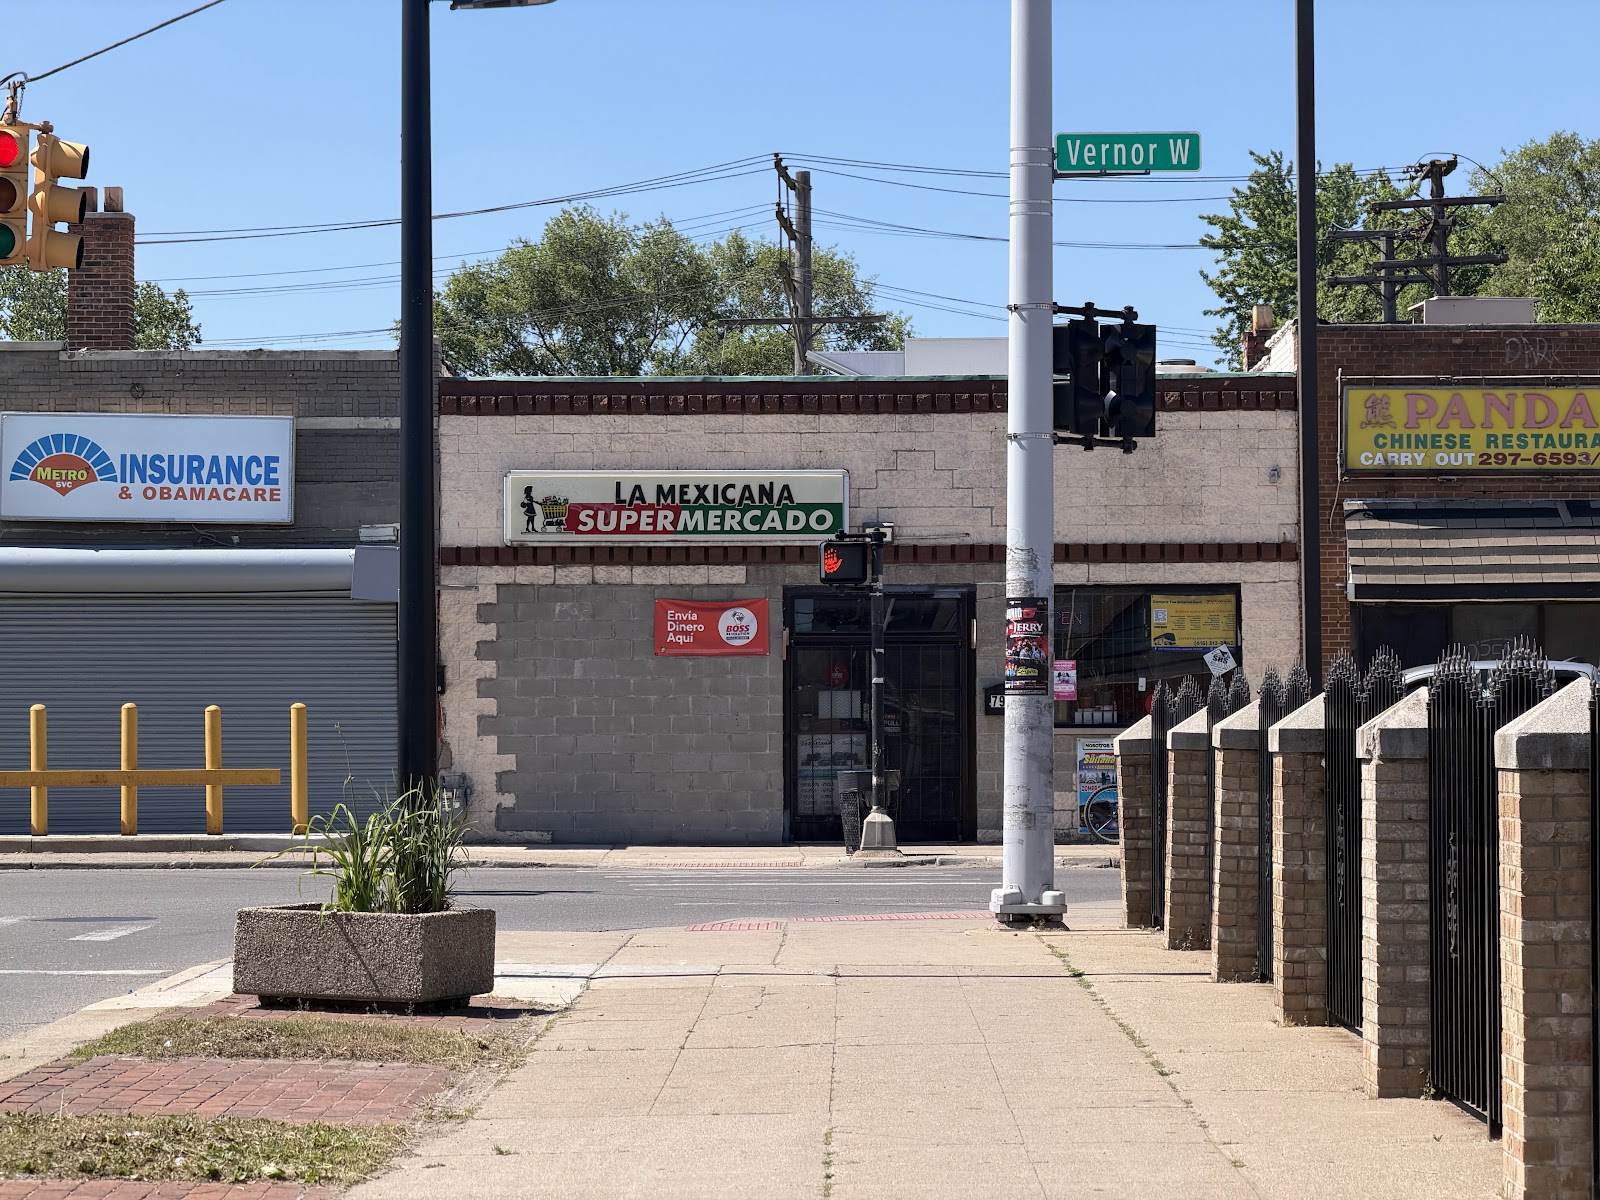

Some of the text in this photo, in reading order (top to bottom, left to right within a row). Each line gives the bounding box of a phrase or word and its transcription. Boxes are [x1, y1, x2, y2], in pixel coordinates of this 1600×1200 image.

[1066, 138, 1190, 166] Vernor W
[1404, 393, 1600, 429] PANDA
[1373, 433, 1600, 449] CHINESE RESTAURA
[1360, 452, 1426, 466] CARRY
[1435, 452, 1476, 466] OUT
[36, 466, 88, 482] METRO
[120, 453, 280, 486] INSURANCE
[55, 481, 73, 489] SVC
[118, 486, 281, 502] & OBAMACARE
[615, 480, 796, 508] LA MEXICANA
[577, 509, 835, 533] SUPERMERCADO
[667, 610, 698, 621] Envía
[667, 622, 705, 632] Dinero
[726, 624, 750, 633] BOSS
[1013, 621, 1044, 633] JERRY
[666, 632, 694, 645] Aquí
